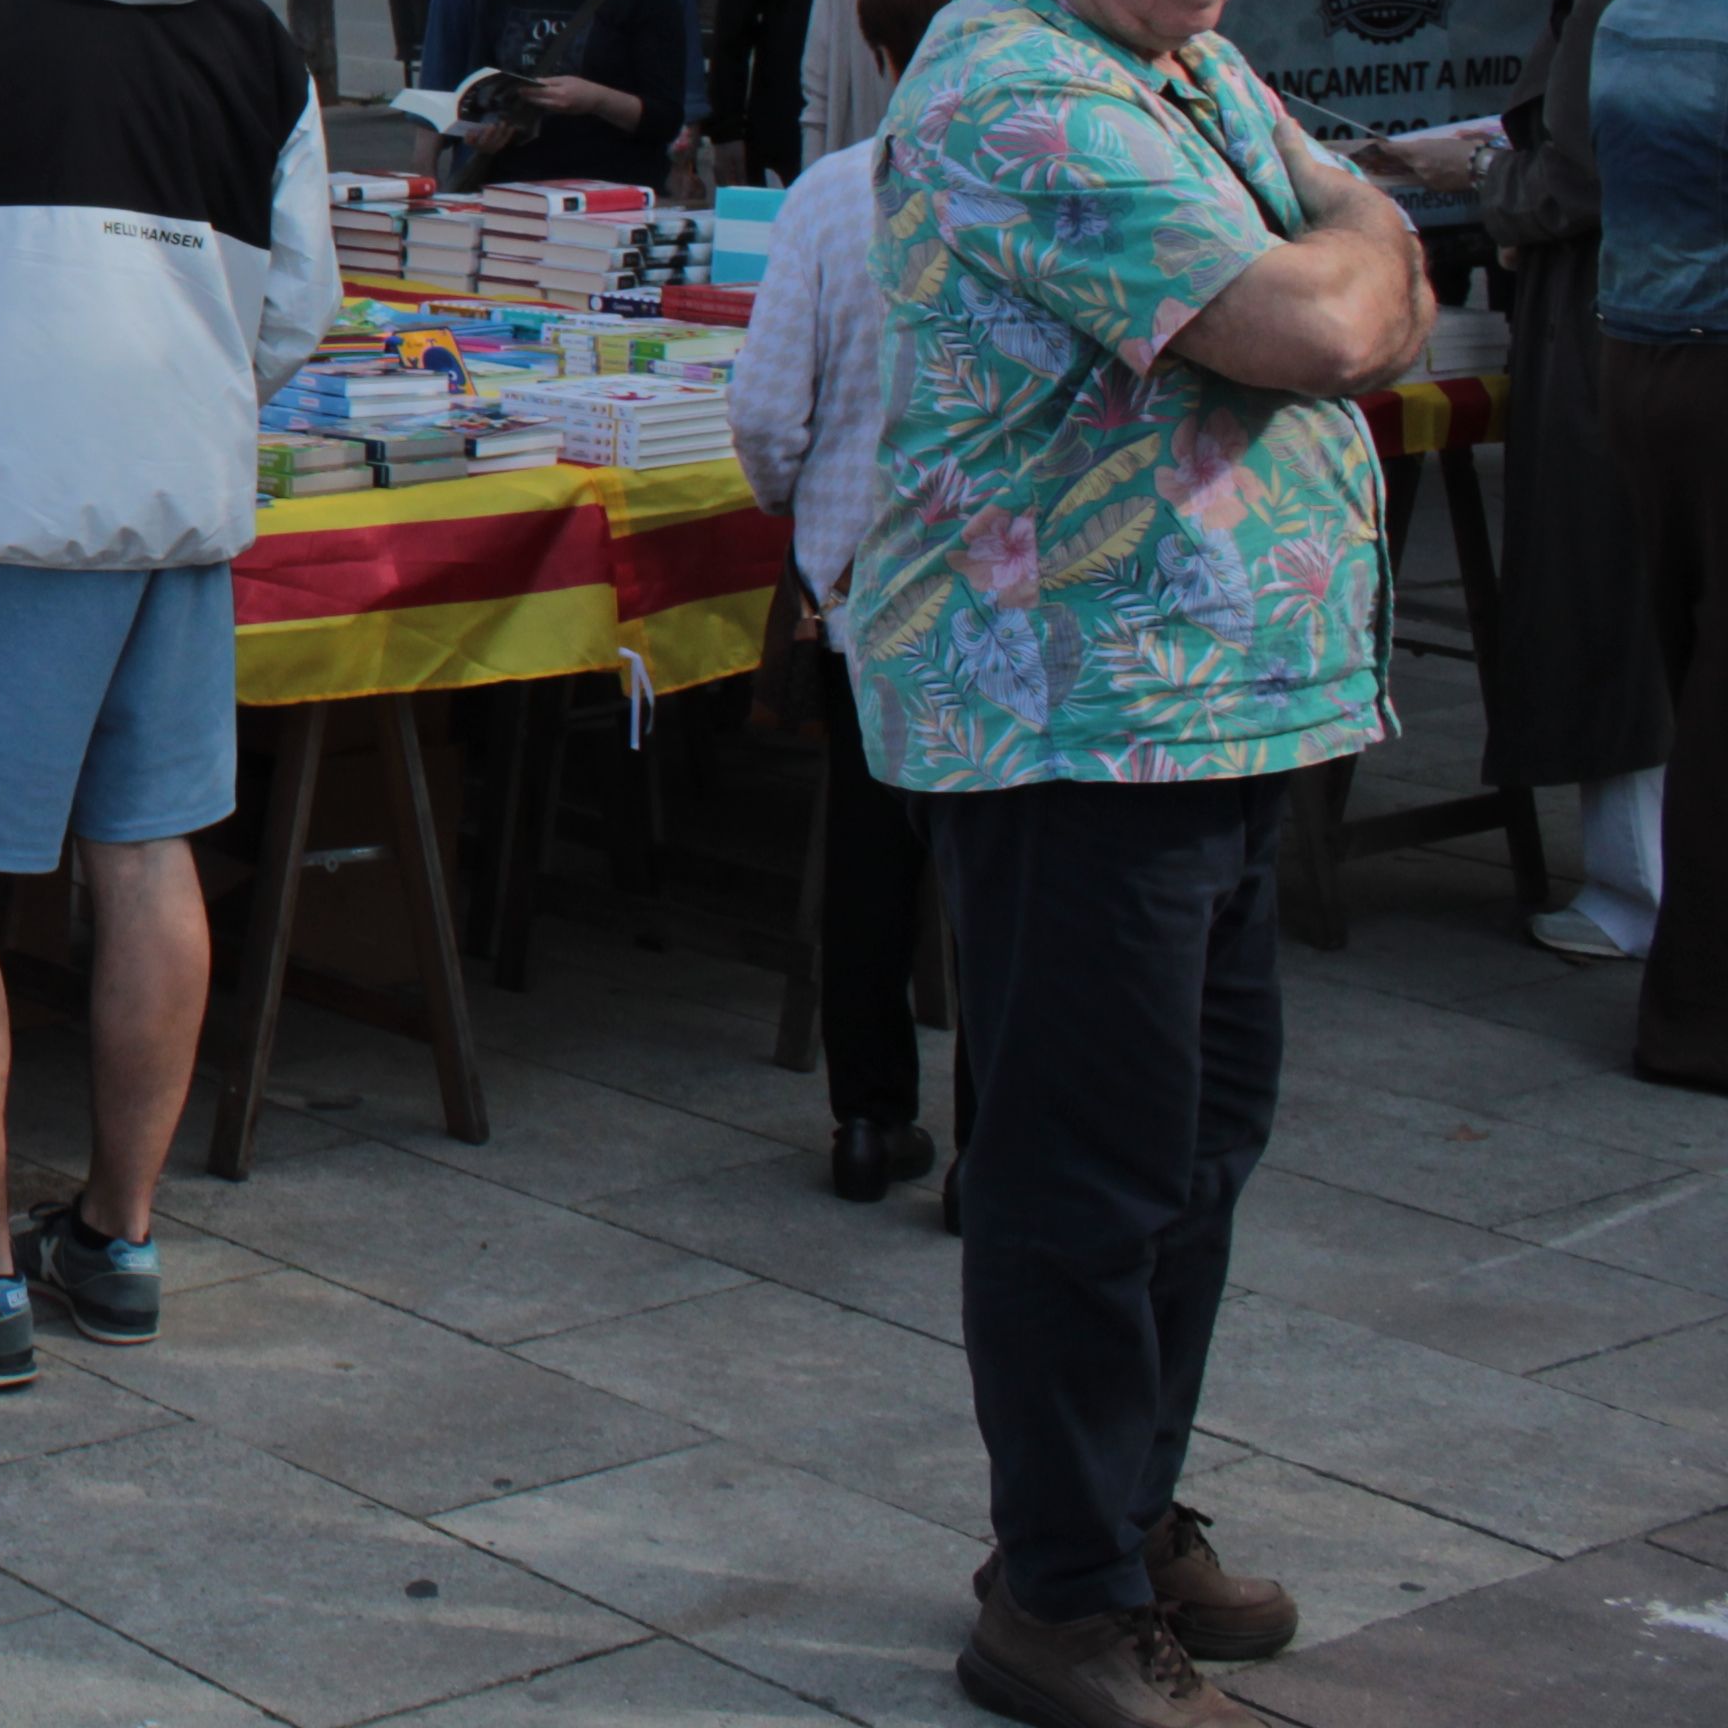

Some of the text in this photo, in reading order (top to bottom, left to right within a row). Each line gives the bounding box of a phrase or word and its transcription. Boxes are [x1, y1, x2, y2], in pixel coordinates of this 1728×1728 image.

[1261, 55, 1523, 103] ANÇAMENT A MID
[140, 226, 204, 250] HANSEN
